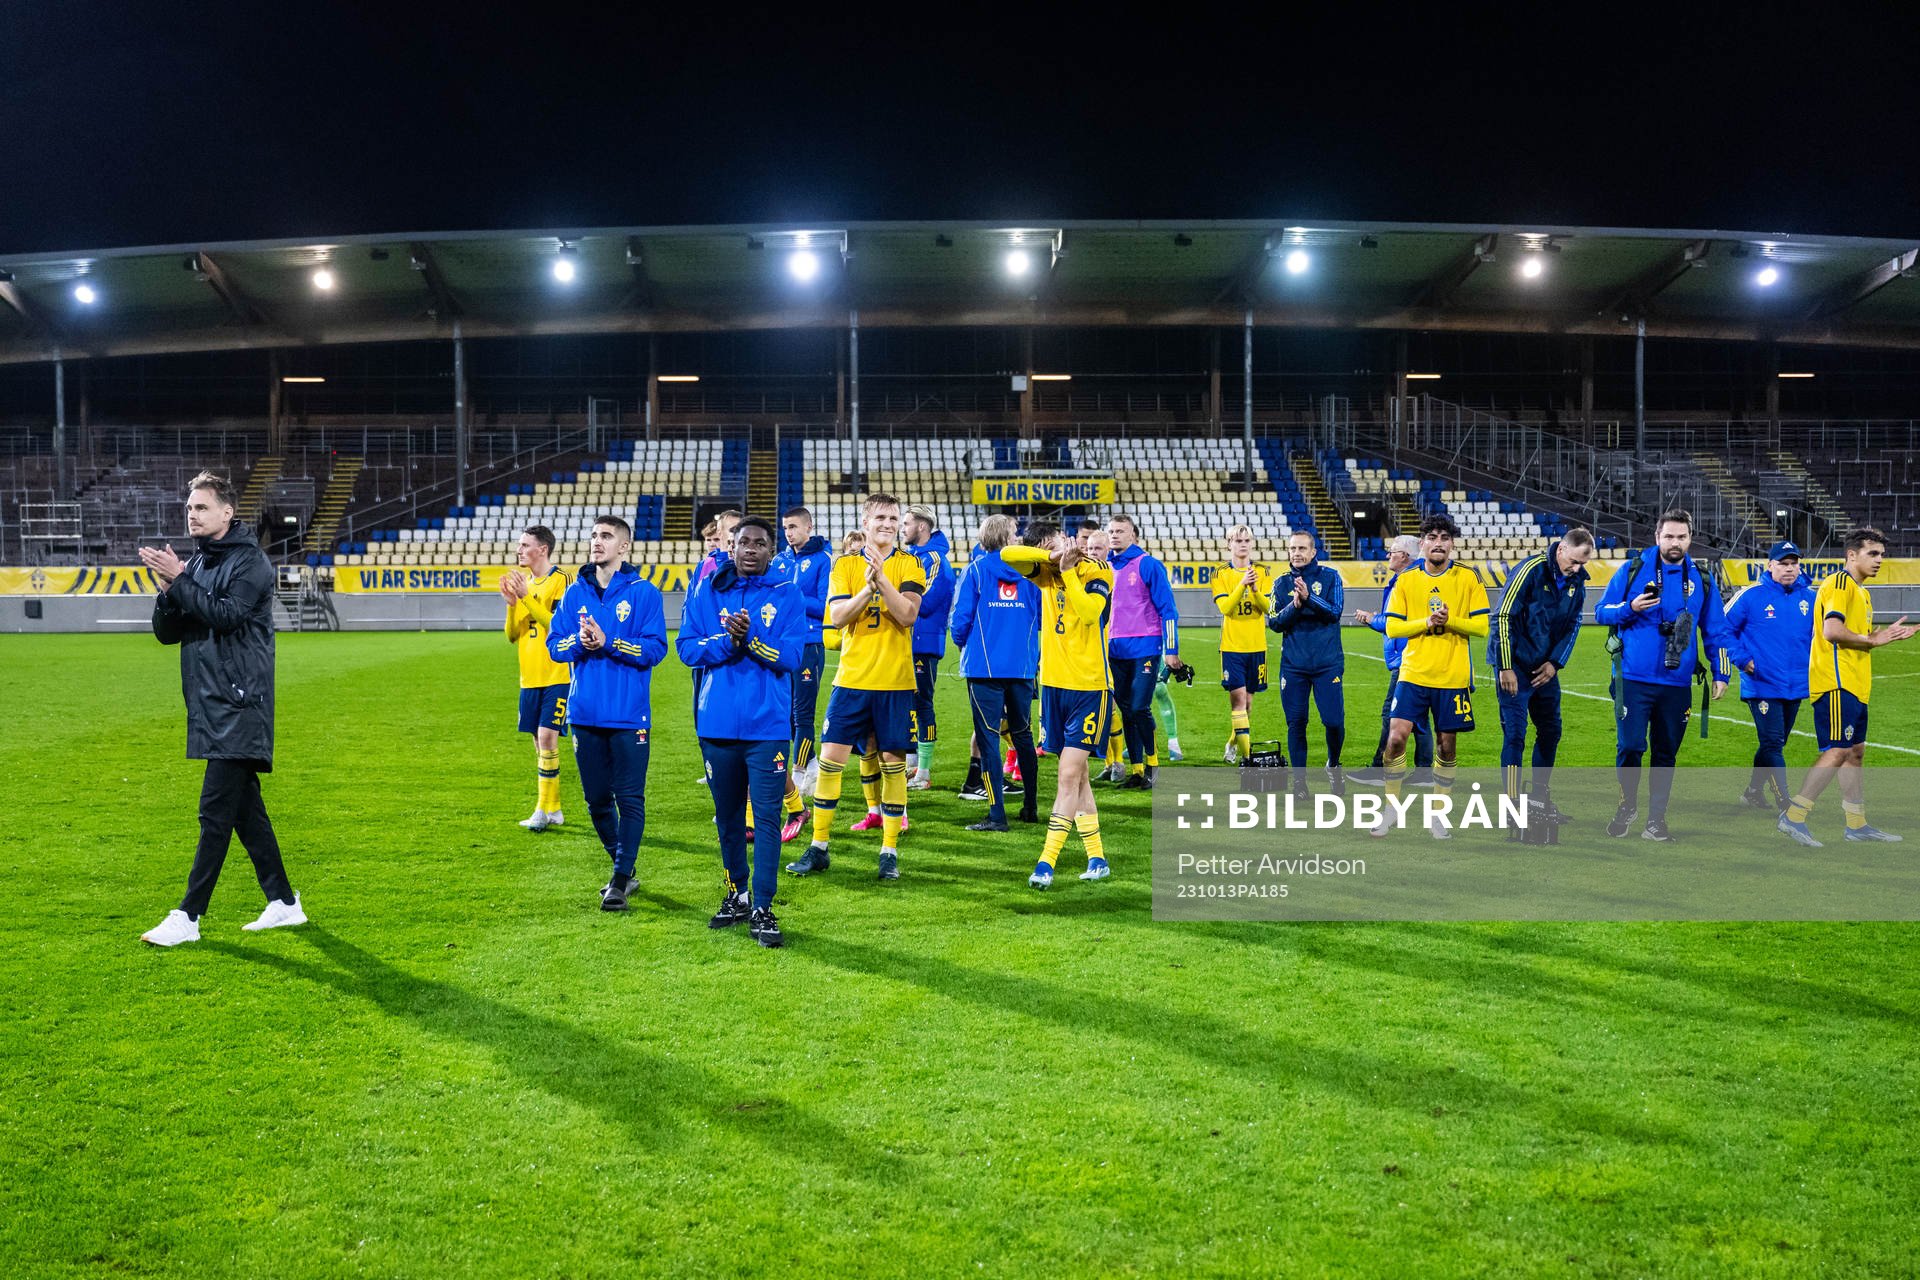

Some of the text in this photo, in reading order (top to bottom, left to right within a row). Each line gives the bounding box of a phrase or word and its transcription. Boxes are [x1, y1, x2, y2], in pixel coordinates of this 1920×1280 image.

[985, 482, 1100, 500] VI ÄR SVERIGE
[360, 569, 480, 588] VI ÄR SVERIGE
[1171, 566, 1194, 584] ÄR
[1746, 563, 1765, 581] VI
[867, 606, 881, 629] 3
[1237, 601, 1253, 616] 18
[528, 620, 538, 638] 5
[1055, 613, 1066, 635] 6
[553, 697, 567, 718] 5
[1453, 693, 1472, 715] 16
[909, 710, 919, 733] 3
[1082, 711, 1097, 735] 6
